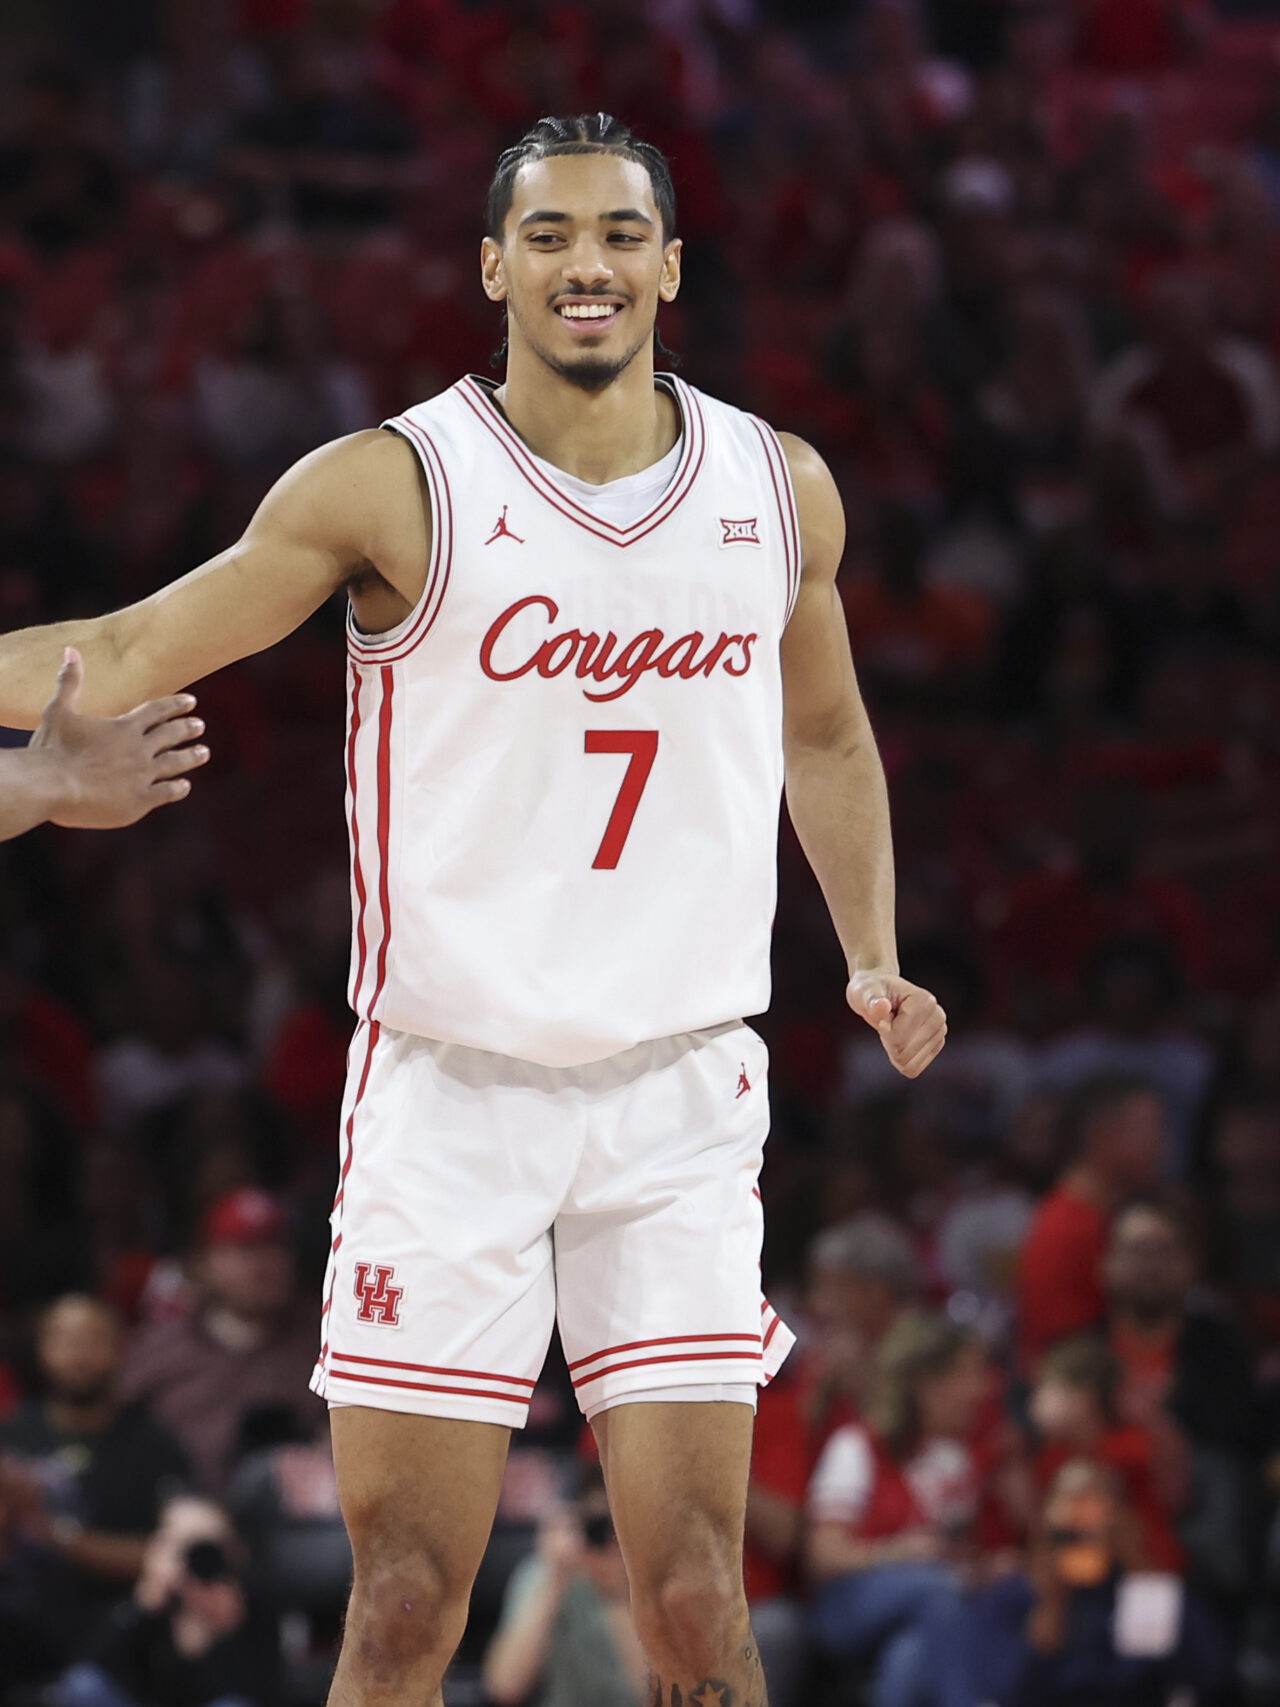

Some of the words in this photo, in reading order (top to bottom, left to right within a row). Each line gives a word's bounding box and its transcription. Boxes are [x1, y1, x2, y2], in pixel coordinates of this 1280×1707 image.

[480, 595, 759, 702] Cougars
[584, 729, 659, 869] 7
[353, 1262, 403, 1326] UH
